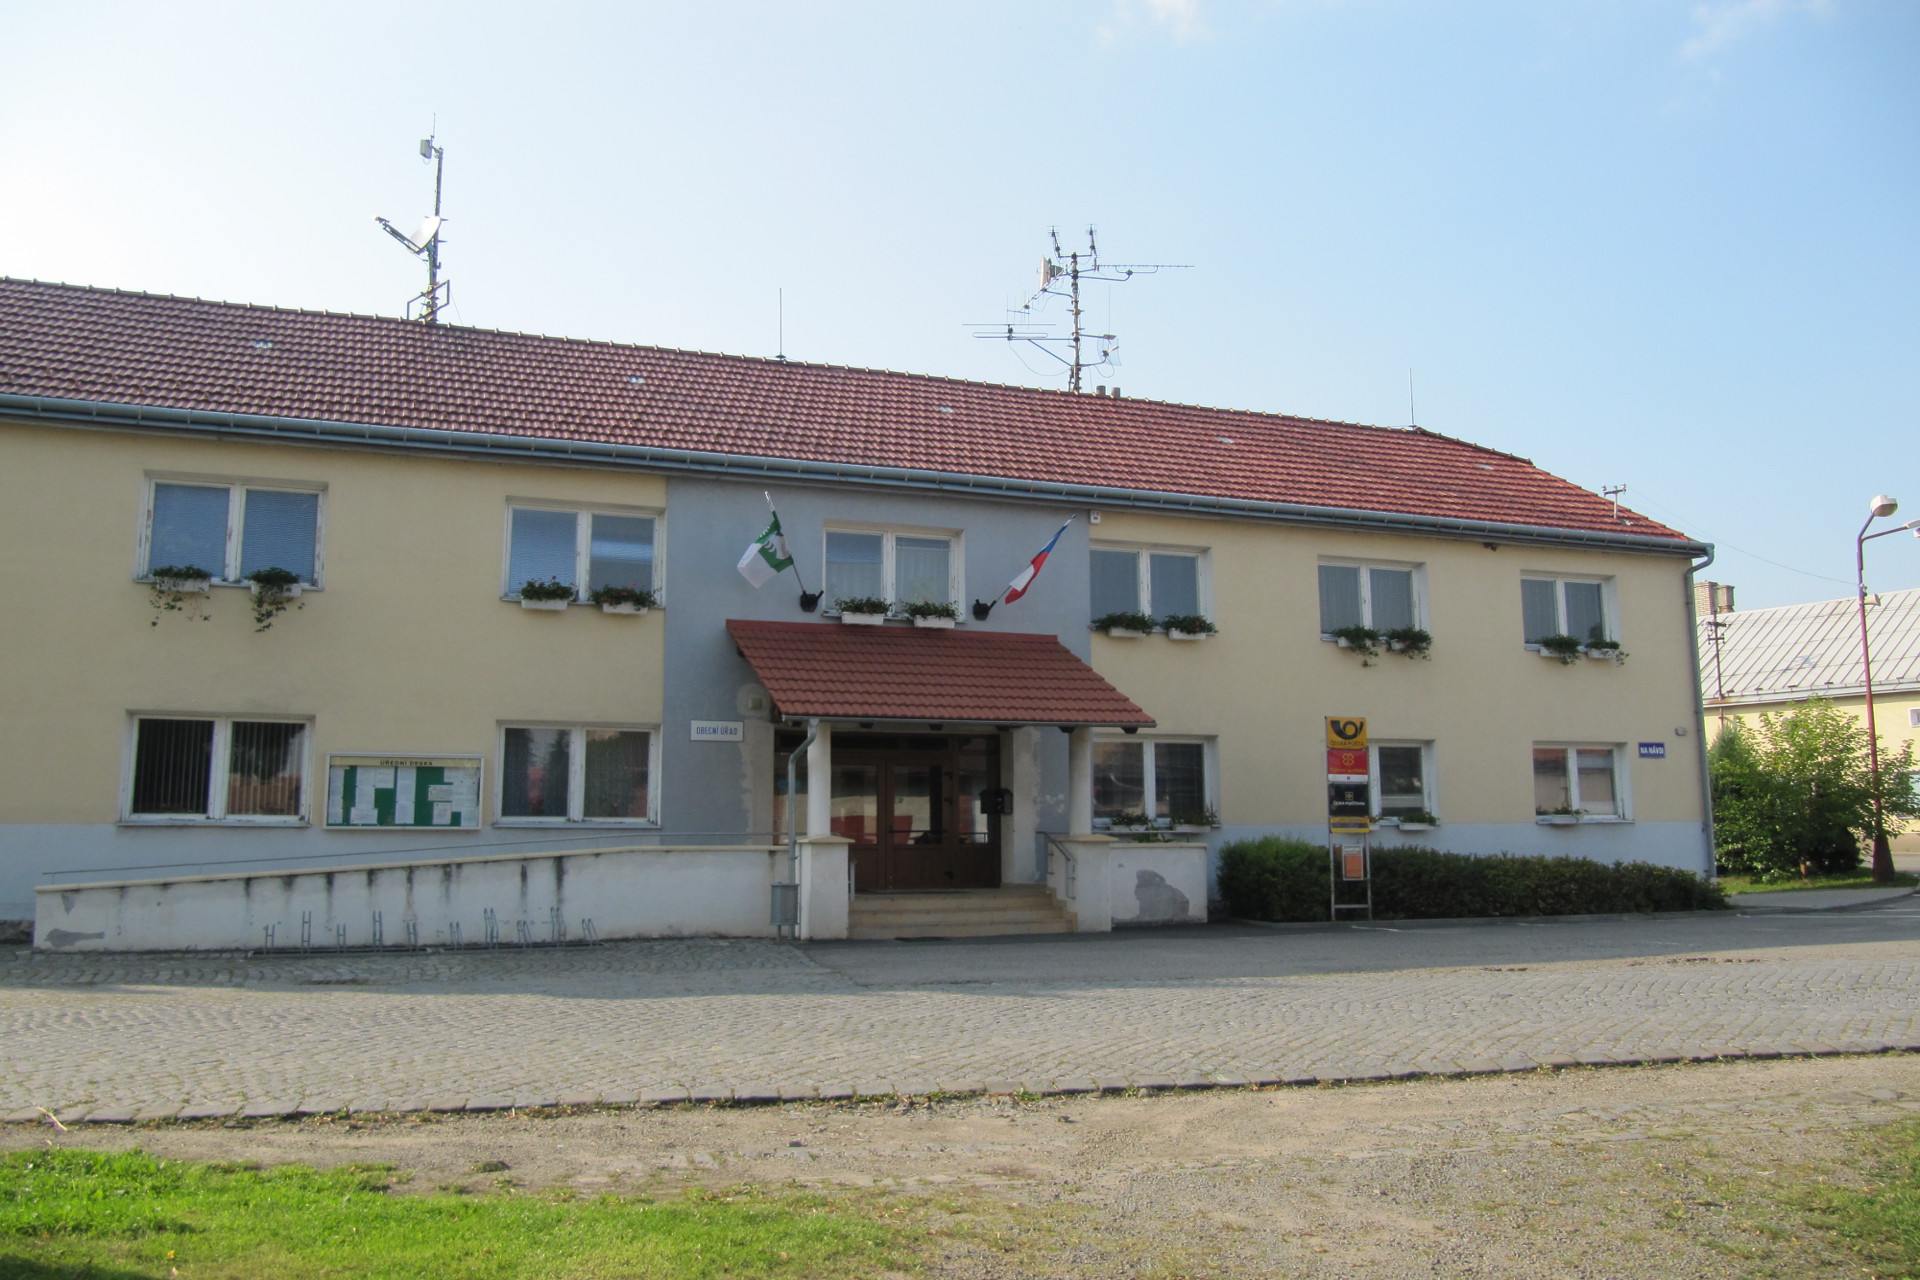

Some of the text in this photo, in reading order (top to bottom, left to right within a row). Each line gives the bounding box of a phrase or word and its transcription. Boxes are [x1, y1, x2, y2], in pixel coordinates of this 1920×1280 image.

[696, 725, 738, 735] OBECNÍ ÚŘAD
[1649, 746, 1664, 754] NÁVSI
